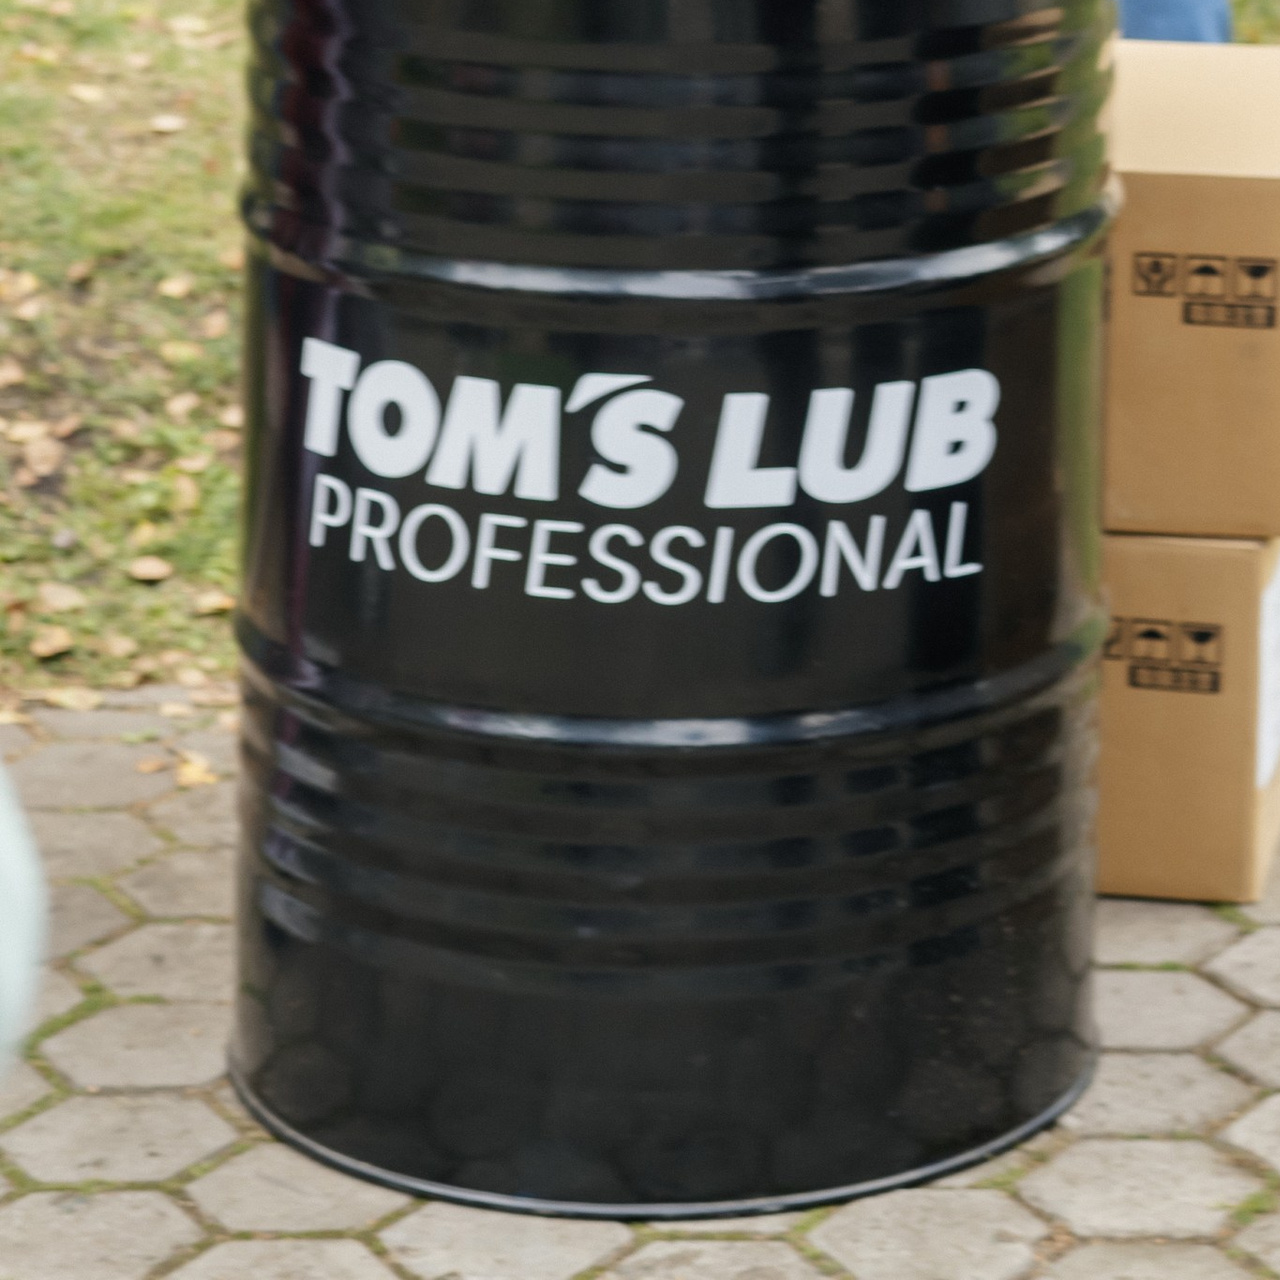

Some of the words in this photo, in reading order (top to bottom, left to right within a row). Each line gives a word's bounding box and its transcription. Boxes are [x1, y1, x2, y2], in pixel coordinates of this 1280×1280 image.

[299, 336, 685, 510] TOM'S
[703, 367, 1001, 509] LUB
[308, 471, 984, 606] PROFESSIONAL
